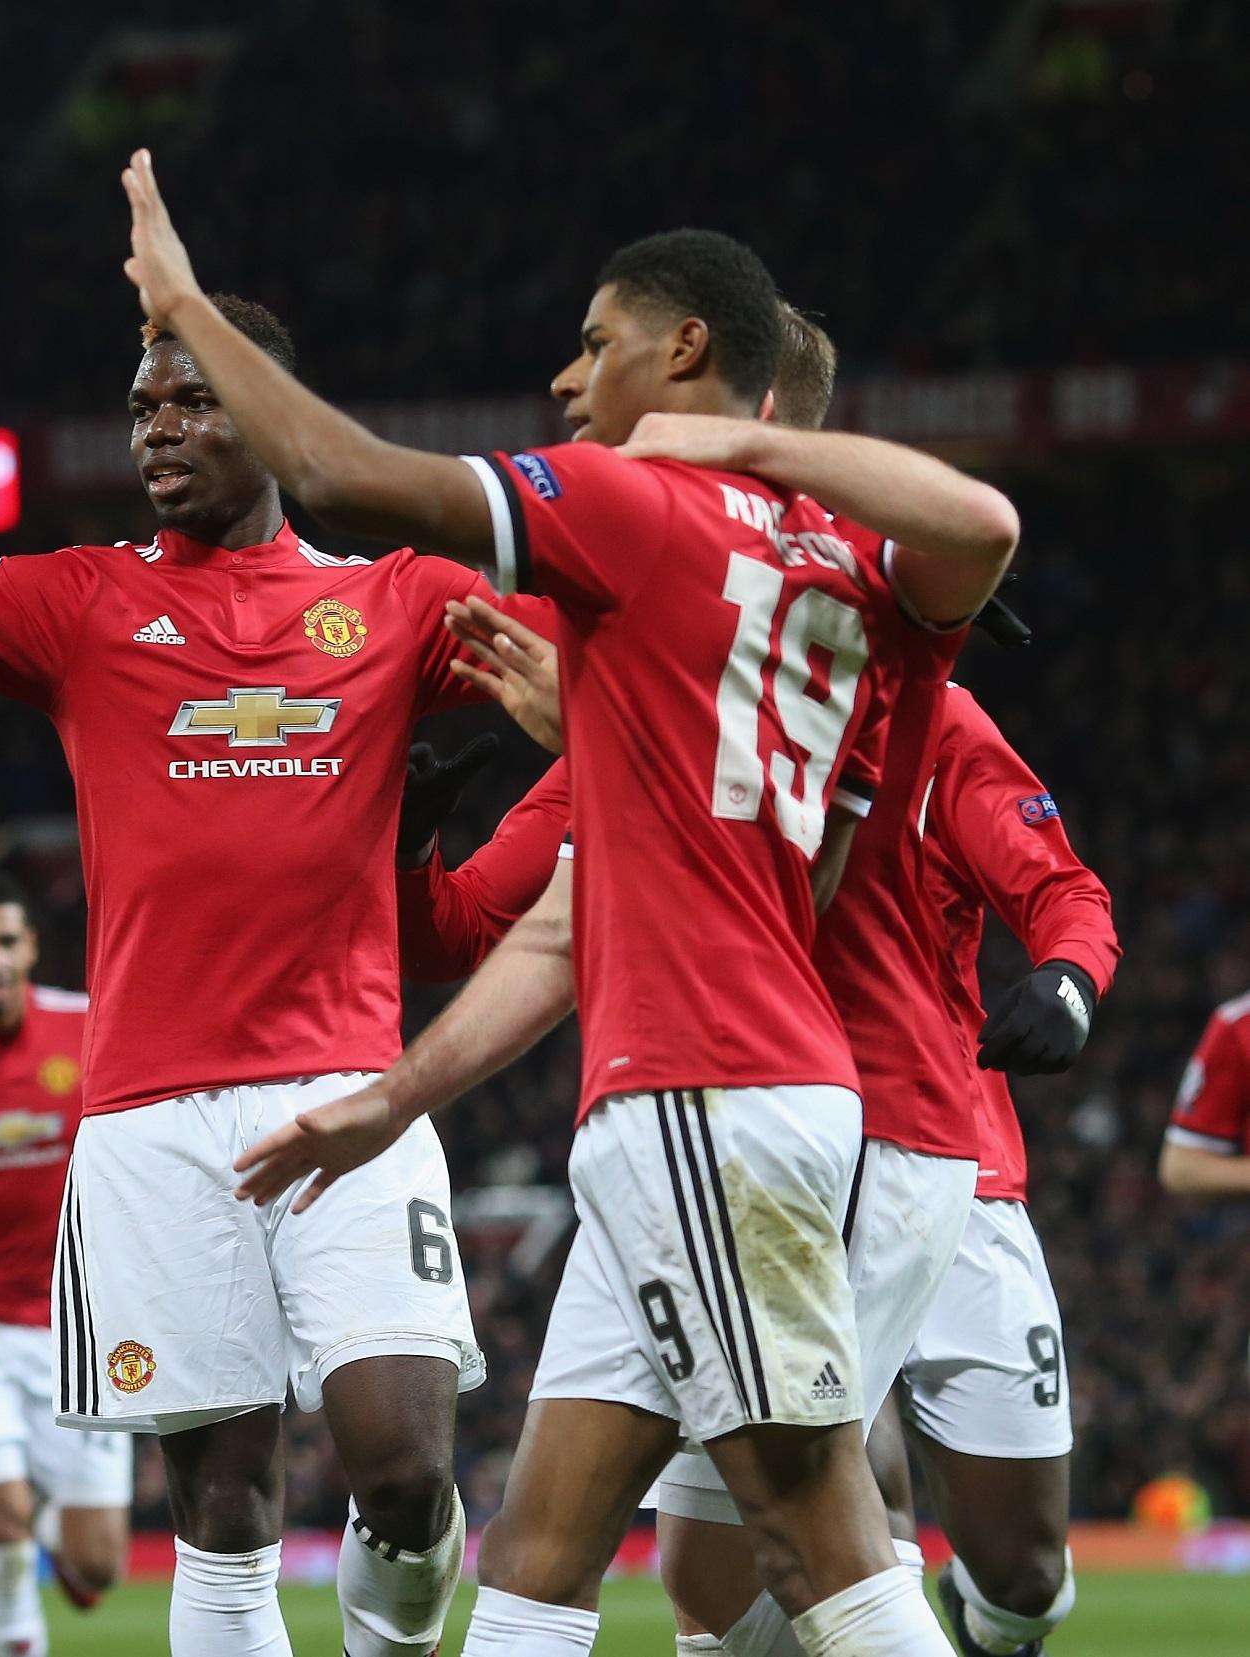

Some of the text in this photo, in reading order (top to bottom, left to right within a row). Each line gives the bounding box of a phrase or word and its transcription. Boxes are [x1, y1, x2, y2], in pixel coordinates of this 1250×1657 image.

[307, 603, 359, 623] MANCHESTER
[132, 632, 187, 645] adidas
[322, 642, 358, 654] UNITED
[711, 550, 869, 862] 19
[168, 757, 344, 779] CHEVROLET
[406, 1197, 453, 1285] 6
[110, 1344, 149, 1364] MANCHESTER
[1026, 1323, 1061, 1407] 9
[119, 1379, 148, 1390] UNITED
[810, 1387, 847, 1400] adidas
